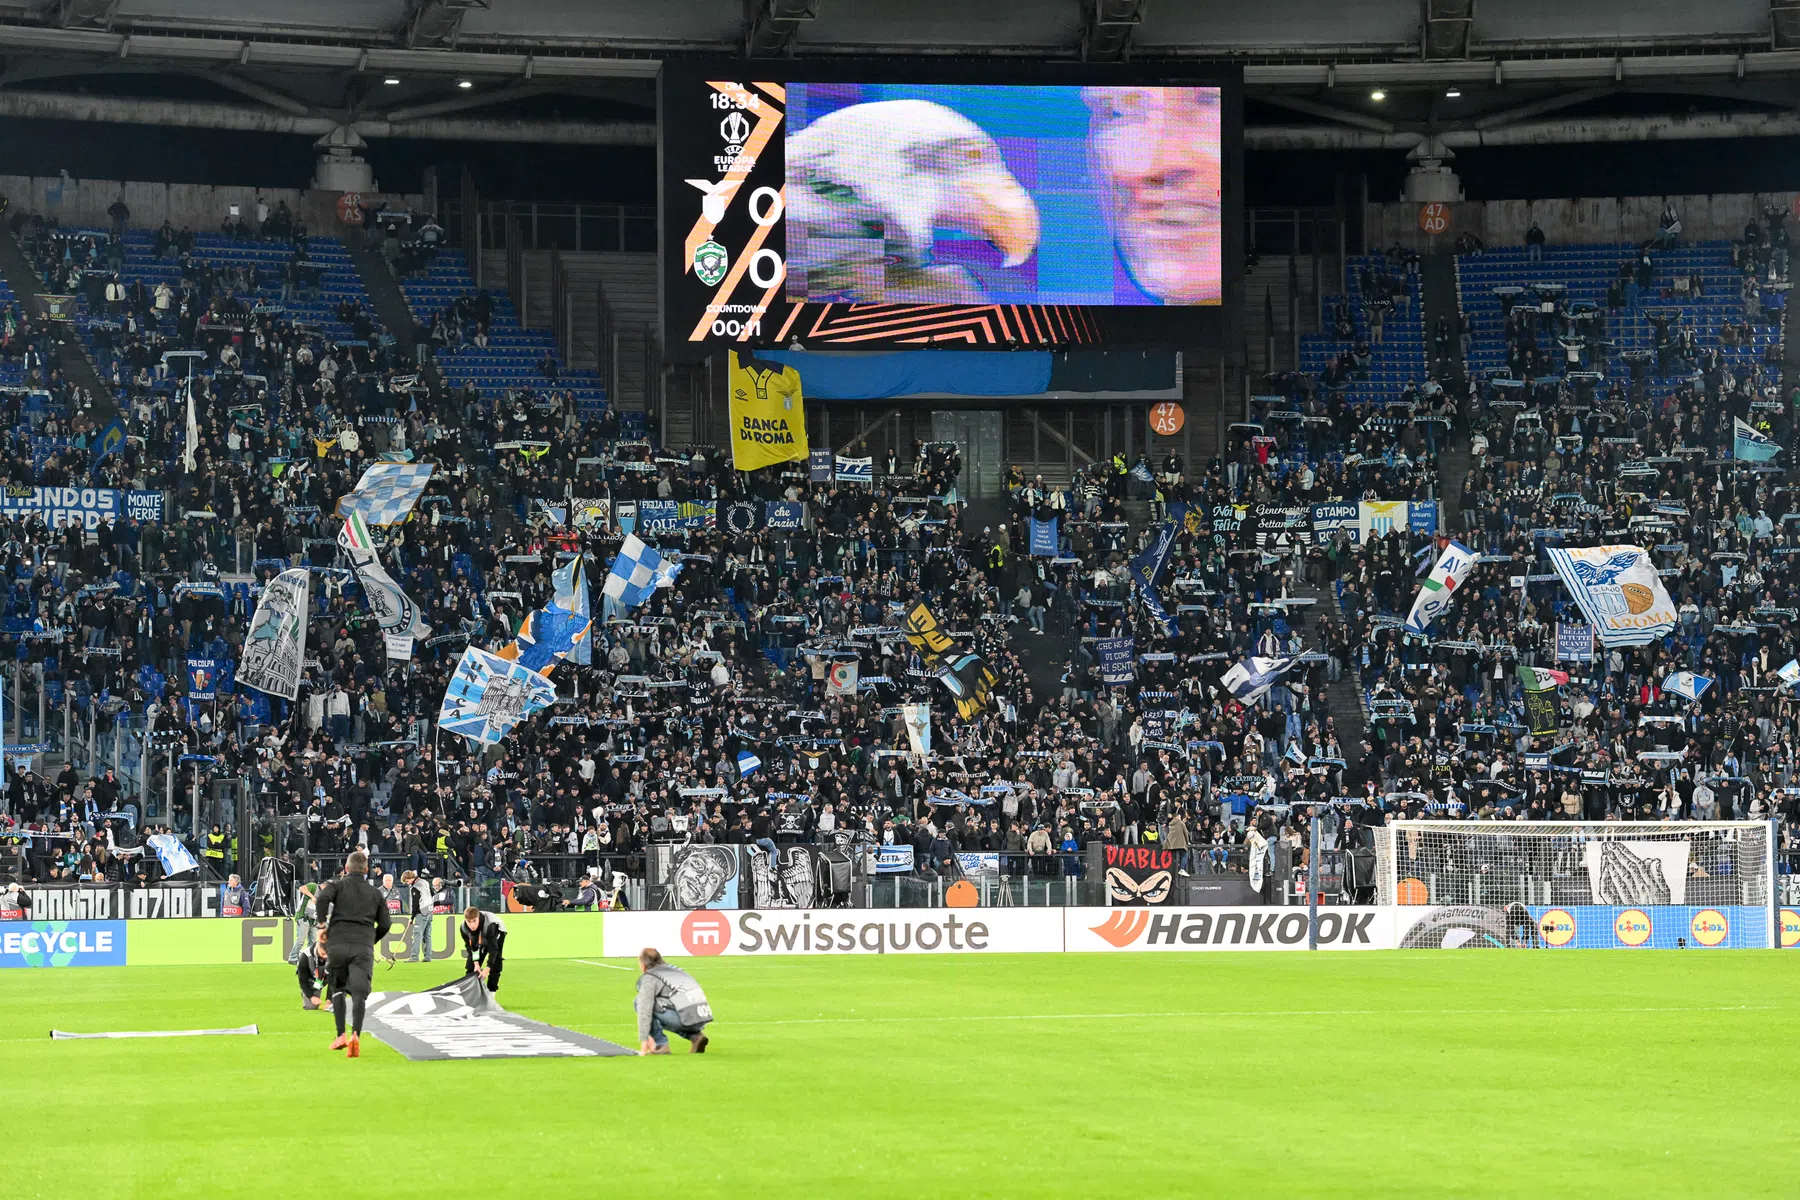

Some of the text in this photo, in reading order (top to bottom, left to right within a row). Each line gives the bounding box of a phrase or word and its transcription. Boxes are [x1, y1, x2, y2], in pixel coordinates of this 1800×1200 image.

[725, 82, 745, 90] ORA
[709, 93, 760, 109] 18:34
[714, 156, 756, 164] EUROPA
[718, 164, 753, 172] LEAGUE
[748, 186, 783, 227] 0
[1426, 204, 1442, 216] 47
[344, 208, 362, 221] AS
[1424, 217, 1445, 231] AD
[748, 248, 783, 289] 0
[706, 304, 767, 313] COUNTDOWN
[711, 320, 761, 336] 00:11
[1157, 403, 1176, 417] 47
[743, 416, 789, 431] BANCA
[1156, 417, 1176, 431] AS
[740, 428, 795, 445] DI ROMA
[128, 494, 161, 508] MONTE
[726, 500, 758, 513] no bullshit
[128, 507, 160, 521] VERDE
[774, 507, 792, 518] che
[1212, 505, 1233, 518] Noi
[1255, 504, 1312, 517] Generazione
[1315, 506, 1356, 517] STAMPO
[767, 517, 799, 529] Lazio!
[1213, 519, 1241, 532] Felici
[1099, 642, 1113, 650] CHE
[188, 659, 215, 668] PER COLPA
[1105, 653, 1113, 662] DI
[1431, 764, 1451, 772] LAZIO
[1105, 844, 1173, 870] DIABLO
[738, 911, 989, 955] Swissquote
[1618, 920, 1648, 933] LIDL
[1694, 920, 1725, 933] LIDL
[0, 931, 113, 955] ECYCLE
